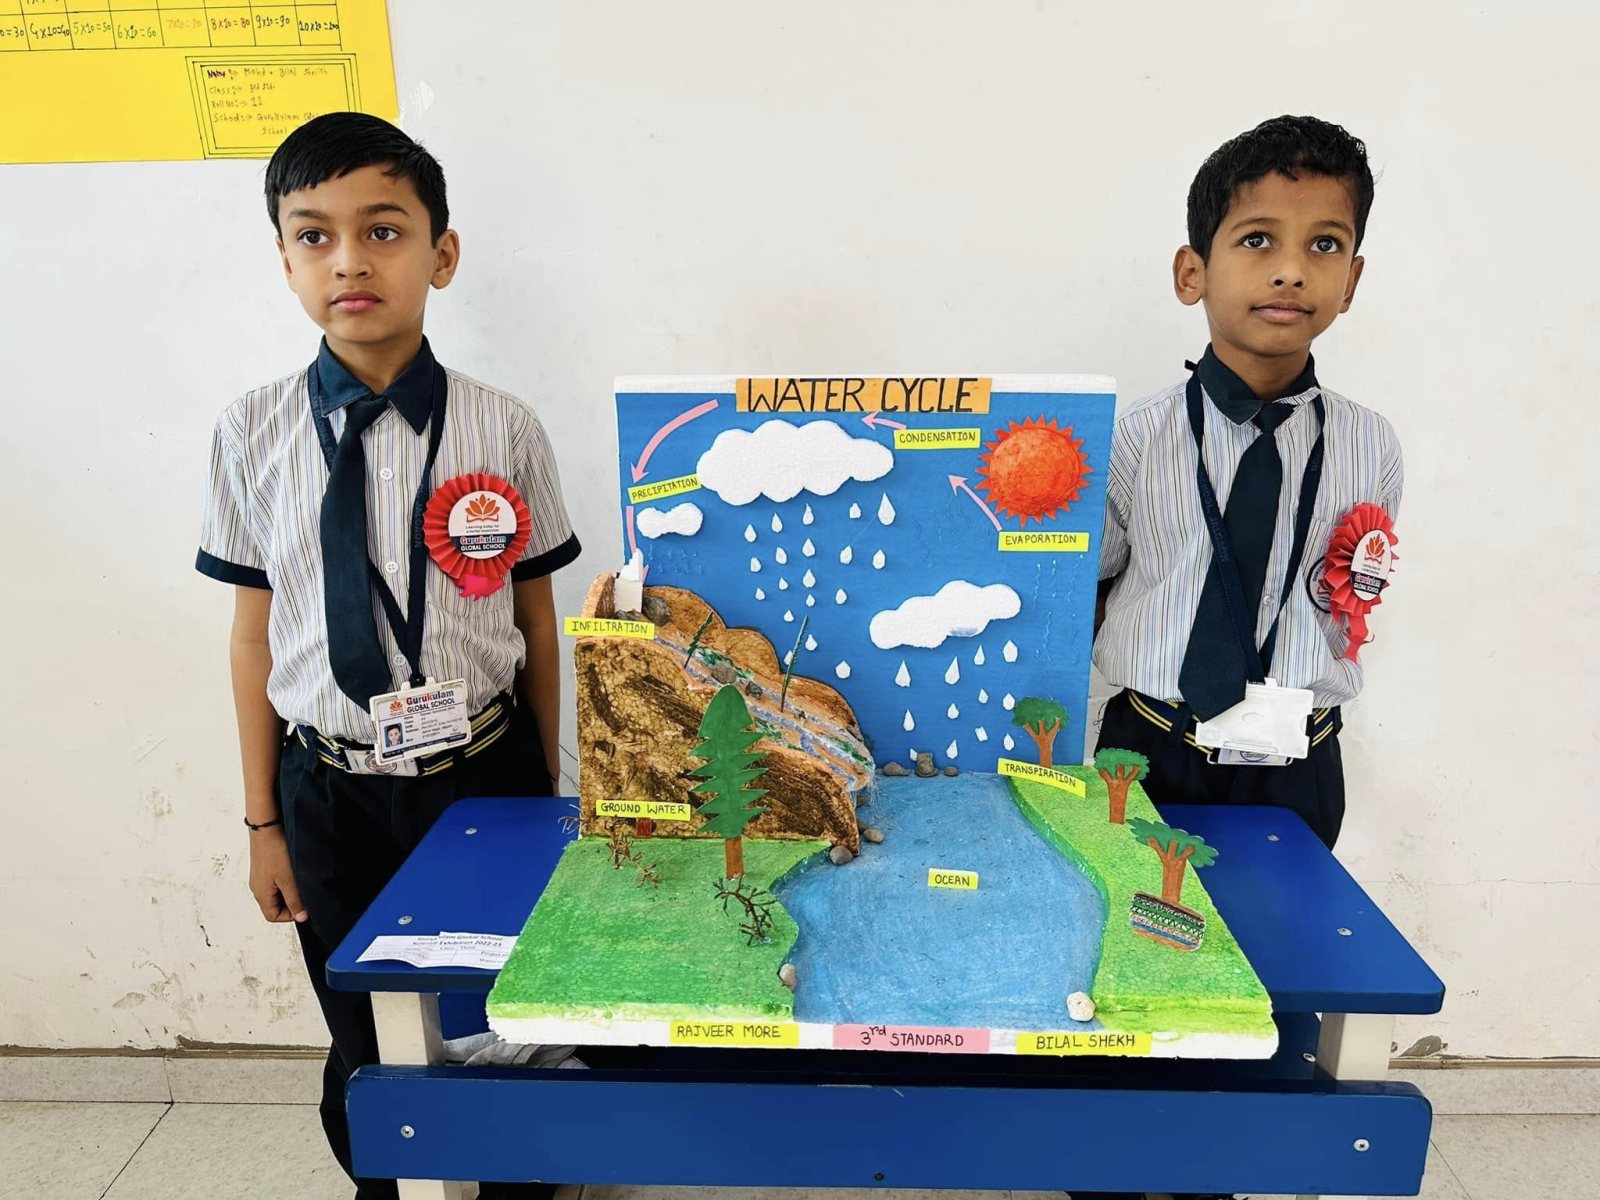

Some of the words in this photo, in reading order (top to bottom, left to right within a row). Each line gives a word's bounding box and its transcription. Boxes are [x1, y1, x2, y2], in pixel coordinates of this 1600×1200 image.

[748, 378, 866, 412] WATER
[881, 378, 978, 413] CYCLE
[899, 430, 976, 443] CONDENSATION
[631, 476, 698, 501] PRECIPITATION
[1005, 533, 1077, 546] EVAPORATION
[572, 621, 648, 634] INFILTRATION
[406, 690, 454, 705] Gurukulam
[407, 703, 430, 713] GLOBAL
[431, 698, 455, 708] SCHOOL
[1004, 763, 1076, 788] TRANSPIRATION
[601, 803, 641, 813] GROUND
[647, 805, 686, 814] WATER
[934, 874, 970, 886] OCEAN
[677, 1025, 734, 1038] RAJVEER
[743, 1025, 781, 1038] MORE
[860, 1025, 887, 1045] 3rd
[890, 1033, 964, 1047] STANDARD
[1036, 1035, 1083, 1049] BILAL
[1088, 1035, 1136, 1048] SHEKH
